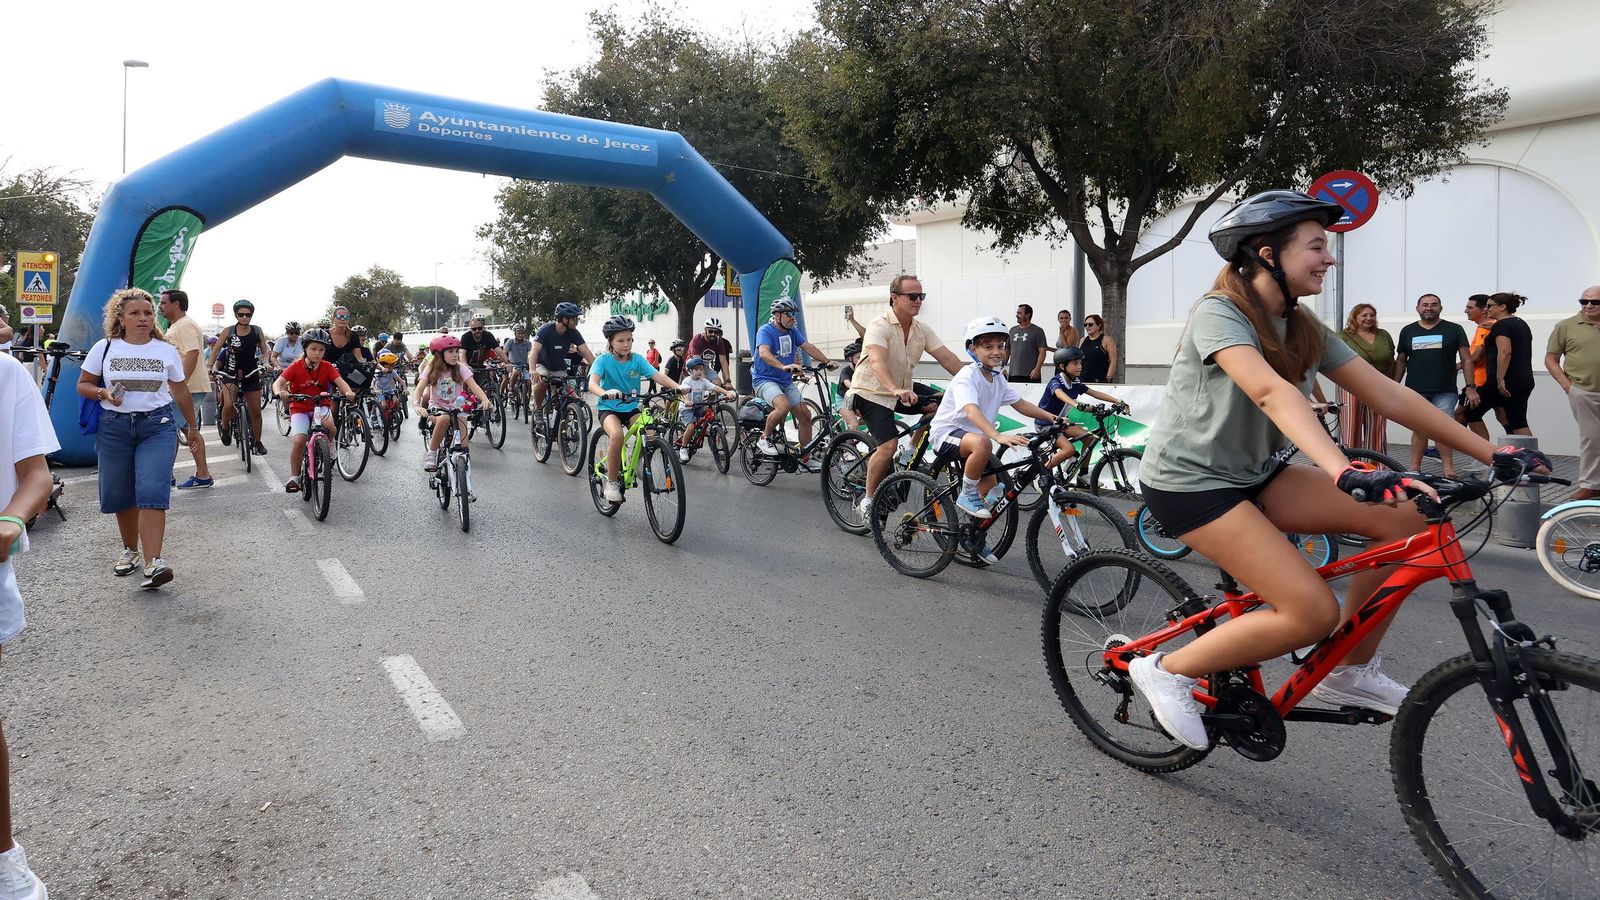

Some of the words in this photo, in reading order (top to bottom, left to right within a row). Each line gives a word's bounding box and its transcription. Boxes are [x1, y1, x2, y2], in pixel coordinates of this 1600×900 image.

[418, 122, 493, 141] Deportes
[419, 110, 571, 142] Ayuntamiento
[576, 133, 600, 146] de
[602, 137, 651, 153] Jerez
[21, 294, 53, 302] PEATONES
